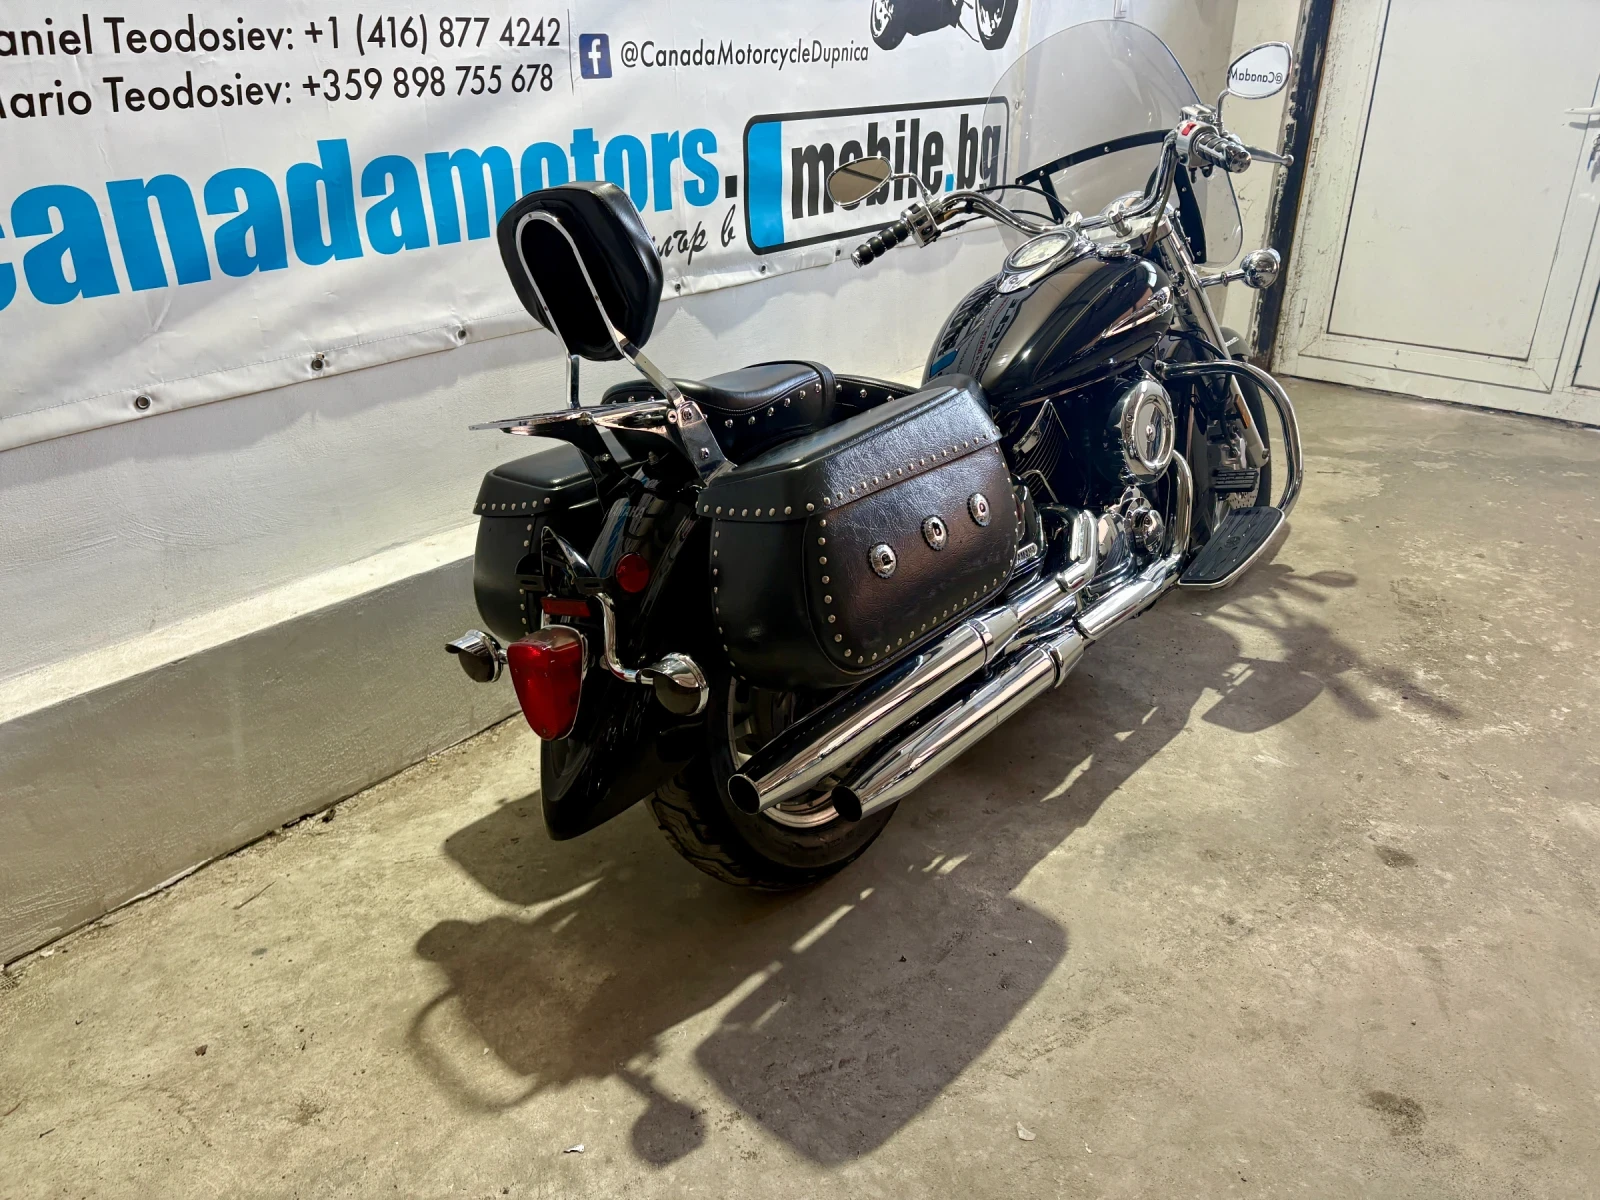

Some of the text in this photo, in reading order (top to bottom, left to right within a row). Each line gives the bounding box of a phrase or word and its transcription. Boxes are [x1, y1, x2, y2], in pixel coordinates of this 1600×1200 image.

[104, 14, 294, 55] Teodosiev:
[305, 17, 339, 50] +1
[357, 14, 428, 57] (416)
[440, 17, 490, 48] 877
[500, 17, 561, 48] 4242
[620, 38, 869, 71] @CanadaMotorcycleDupnica
[103, 70, 293, 113] Teodosiev:
[303, 68, 384, 102] +359
[394, 66, 446, 99] 898
[456, 65, 502, 97] 755
[512, 63, 553, 94] 678
[0, 127, 738, 312] anadamotors.
